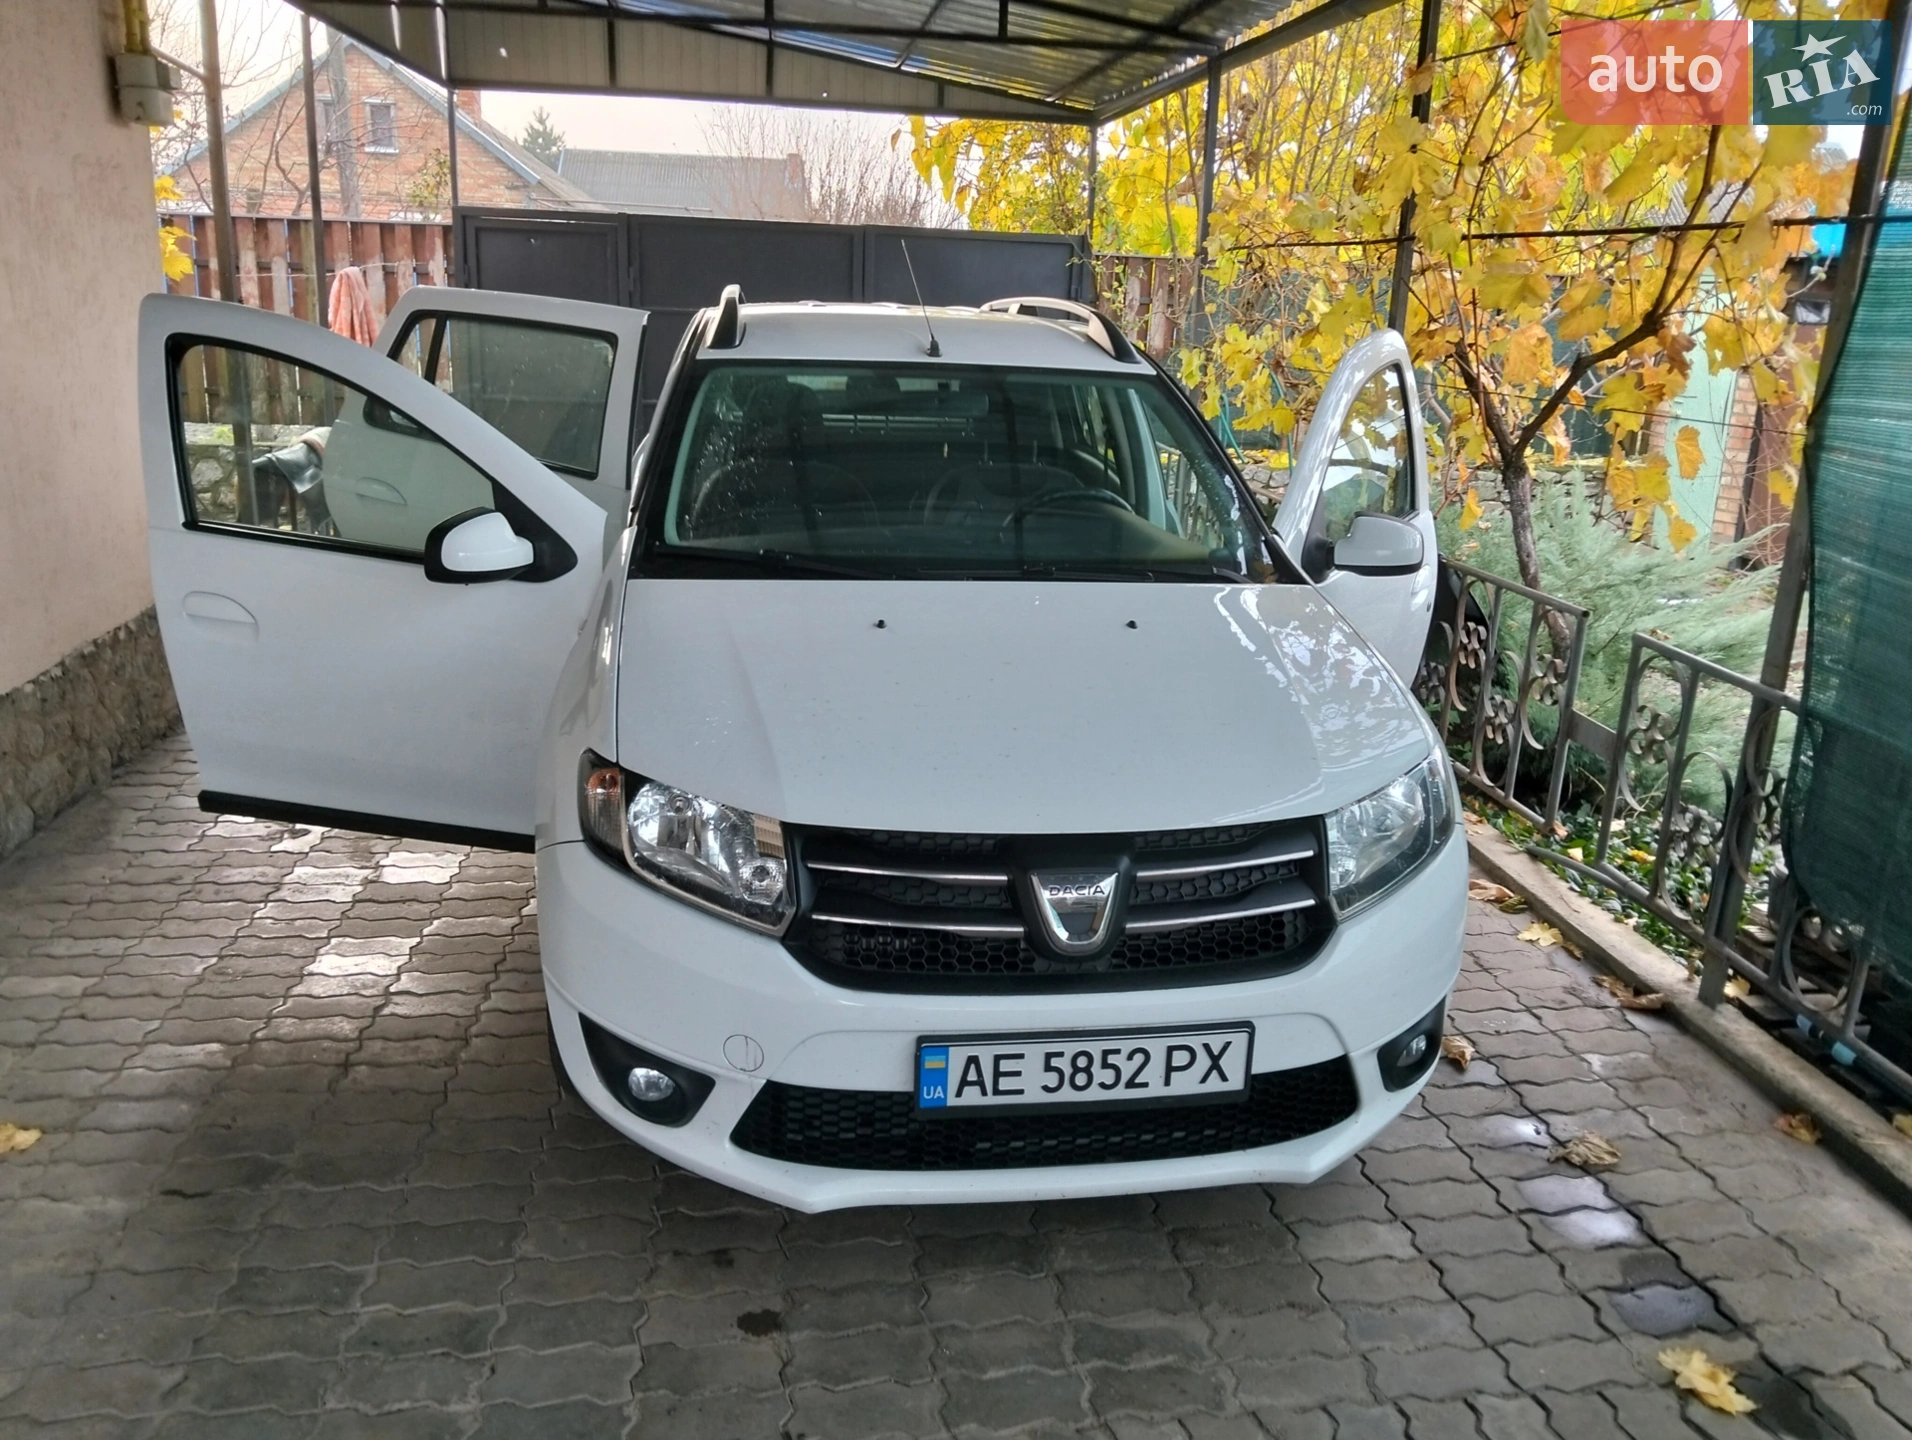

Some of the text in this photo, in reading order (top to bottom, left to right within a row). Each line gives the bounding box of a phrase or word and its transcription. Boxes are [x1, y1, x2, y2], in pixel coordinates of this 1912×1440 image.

[1048, 884, 1105, 896] DACIA
[954, 1041, 1233, 1098] AE 5852 PX
[923, 1085, 945, 1099] UA
